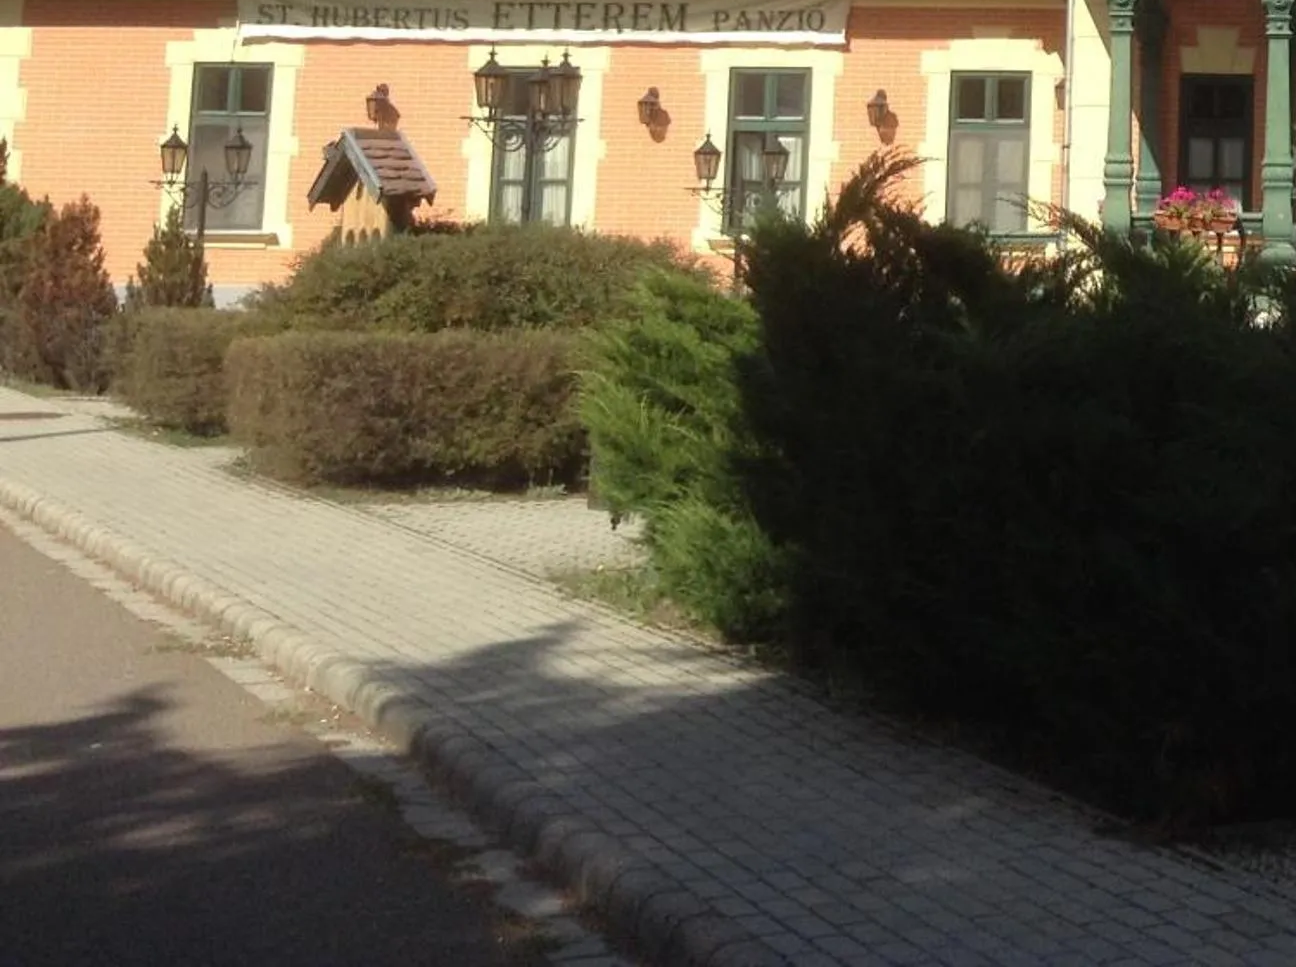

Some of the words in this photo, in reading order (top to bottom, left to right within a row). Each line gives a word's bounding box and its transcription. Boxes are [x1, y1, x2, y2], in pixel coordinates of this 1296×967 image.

[256, 3, 300, 26] ST.
[310, 4, 470, 30] HUBERTUS
[712, 3, 827, 32] PANZIÓ
